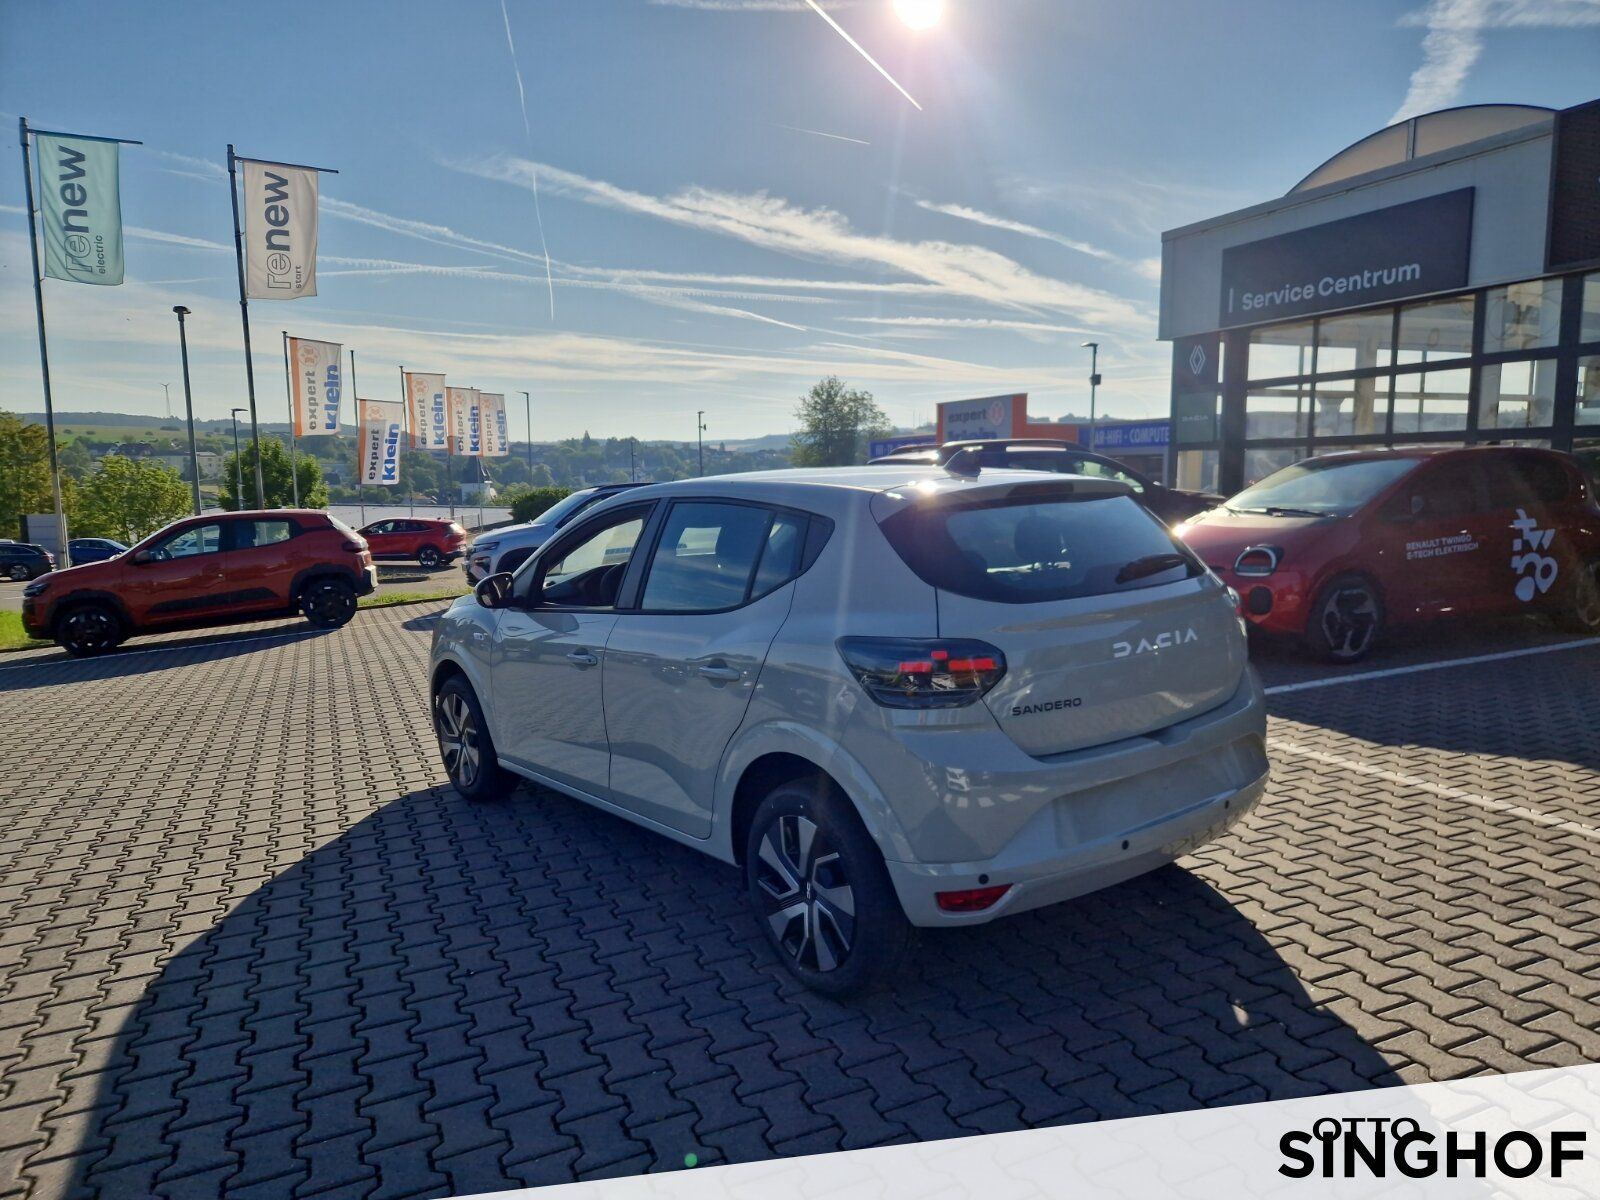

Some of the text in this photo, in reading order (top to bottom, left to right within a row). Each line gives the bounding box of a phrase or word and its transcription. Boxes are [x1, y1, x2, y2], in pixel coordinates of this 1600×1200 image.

[58, 144, 93, 273] renew
[264, 171, 292, 290] renew
[96, 234, 106, 275] electric
[1242, 262, 1421, 311] Service Centrum
[305, 370, 317, 430] expert
[324, 364, 341, 430] klein
[431, 392, 445, 445] klein
[417, 398, 427, 445] expert
[456, 409, 464, 452] expert
[468, 405, 480, 452] klein
[485, 413, 493, 452] expert
[497, 409, 507, 452] klein
[1091, 429, 1122, 445] AR-HIFI
[368, 428, 380, 480] expert
[382, 423, 400, 481] klein
[1406, 538, 1440, 551] RENAULT
[1112, 628, 1198, 658] DACIA
[1012, 697, 1082, 716] SANDERO
